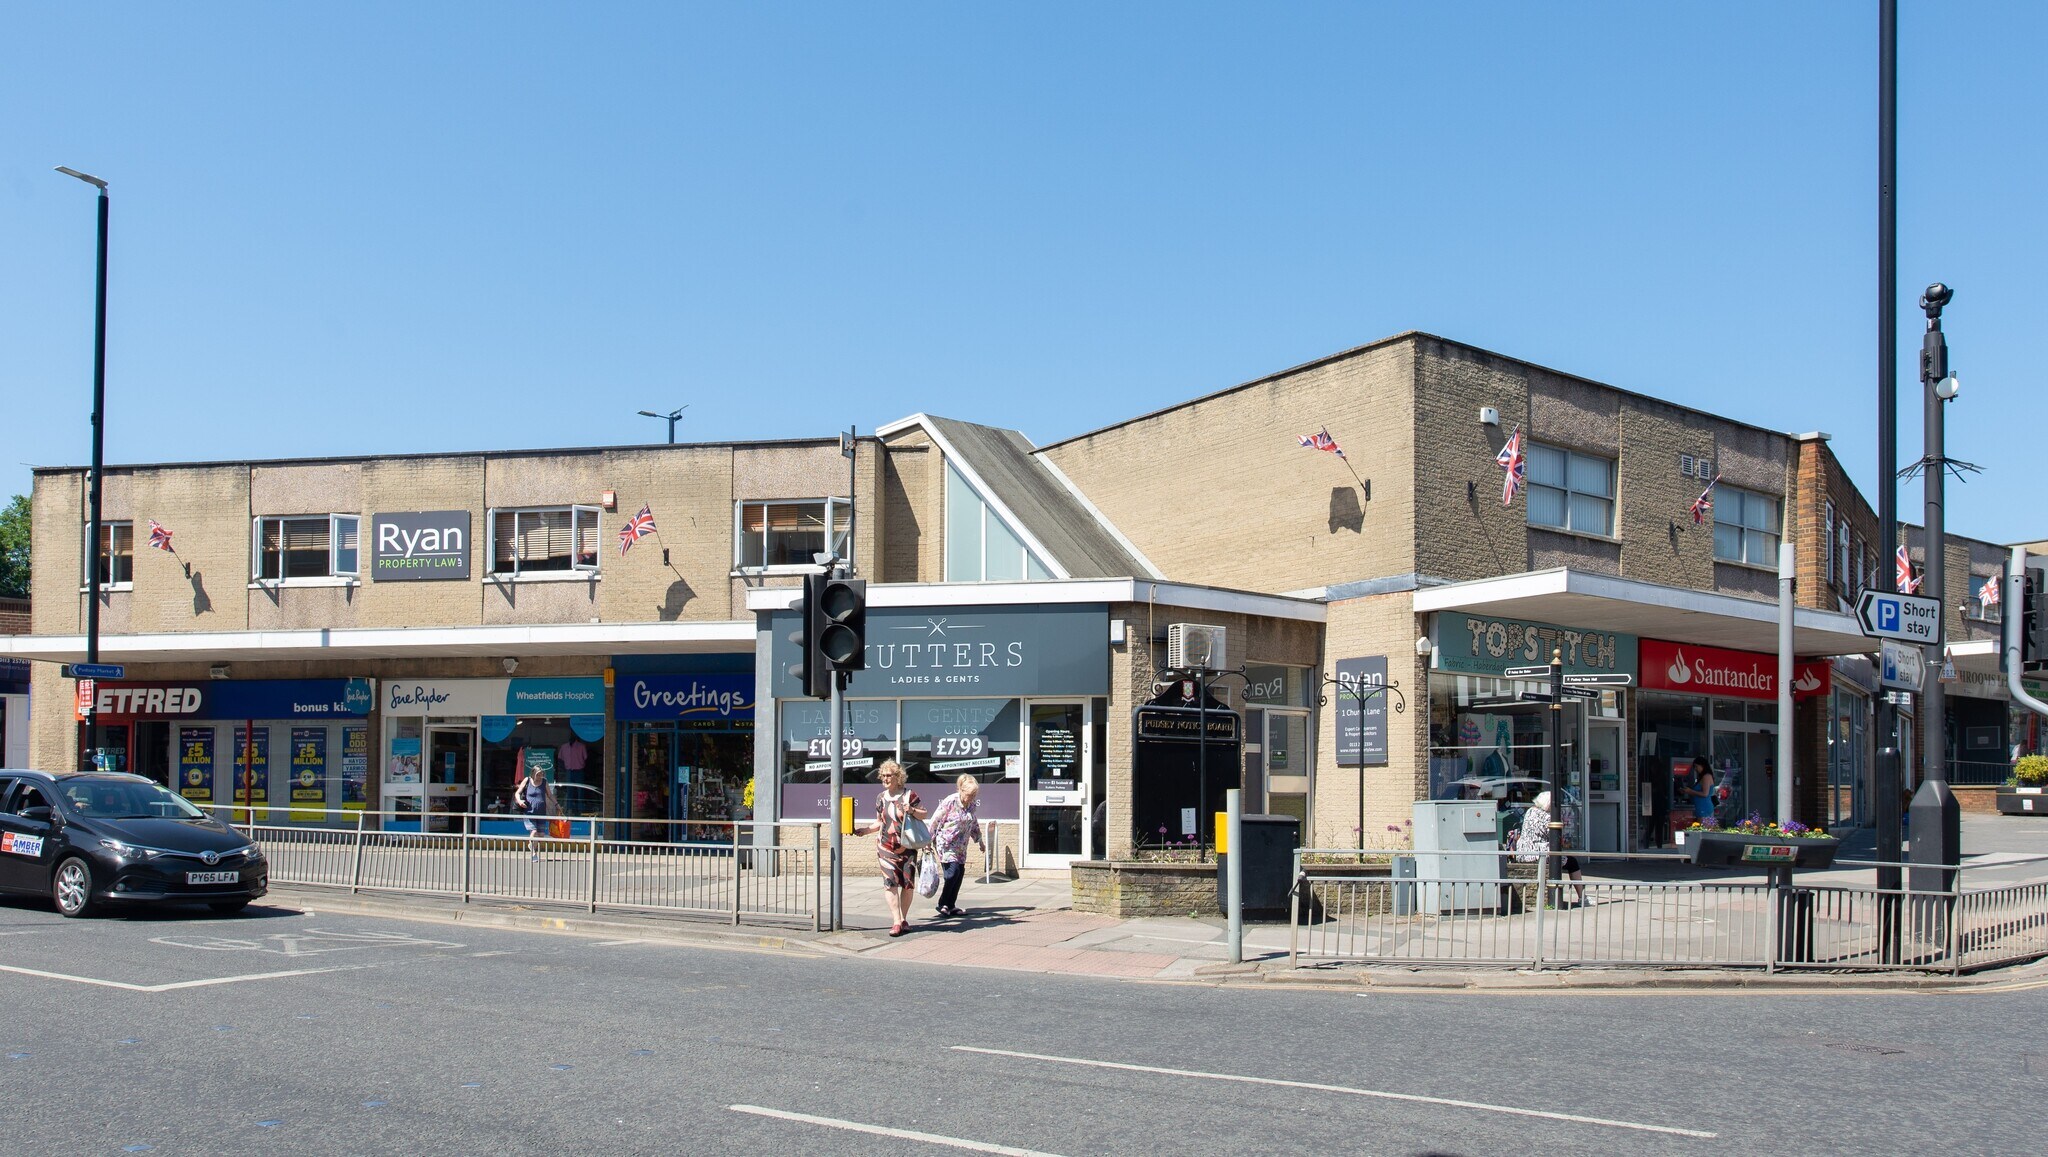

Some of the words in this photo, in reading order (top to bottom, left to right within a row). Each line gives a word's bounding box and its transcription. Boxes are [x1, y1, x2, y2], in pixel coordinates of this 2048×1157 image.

[379, 523, 463, 558] Ryan
[379, 558, 432, 569] PROPERTY
[434, 558, 457, 568] LAW
[1881, 603, 1896, 628] P
[1903, 602, 1936, 619] Short
[1907, 621, 1931, 638] stay
[1466, 617, 1617, 670] TOPSTITCH
[1444, 659, 1465, 670] Fabric
[1897, 650, 1915, 667] Short
[891, 676, 930, 684] LADIES
[934, 675, 941, 683] &
[945, 675, 980, 683] GENTS
[1339, 671, 1383, 693] Ryan
[1694, 658, 1773, 691] Santander
[1899, 670, 1913, 685] stay
[1959, 670, 1997, 687] HROOMS
[96, 688, 202, 714] ETFRED
[391, 684, 414, 709] Sue
[414, 686, 451, 711] Ryder
[516, 691, 563, 700] Wheatfields
[564, 691, 595, 702] Hospice
[633, 680, 745, 716] Greetings
[293, 702, 329, 713] bonus
[1341, 709, 1346, 717] 1
[1366, 707, 1381, 716] Lane
[801, 709, 880, 724] LAIES
[927, 708, 996, 723] GENTS
[817, 726, 856, 736] TRMS
[944, 725, 978, 735] CUTS
[1144, 720, 1175, 729] PUDSEY
[1177, 721, 1201, 730] NOTIC
[1206, 722, 1233, 731] BOARD
[350, 731, 366, 740] BES
[187, 742, 204, 757] £5
[299, 743, 316, 758] £5
[936, 737, 983, 756] £7.99
[181, 756, 211, 765] MILLION
[293, 757, 323, 766] MILLION
[941, 761, 971, 769] APPOINTMENT
[13, 839, 41, 852] AMBER
[191, 872, 216, 883] PY65
[217, 872, 236, 883] LFA
